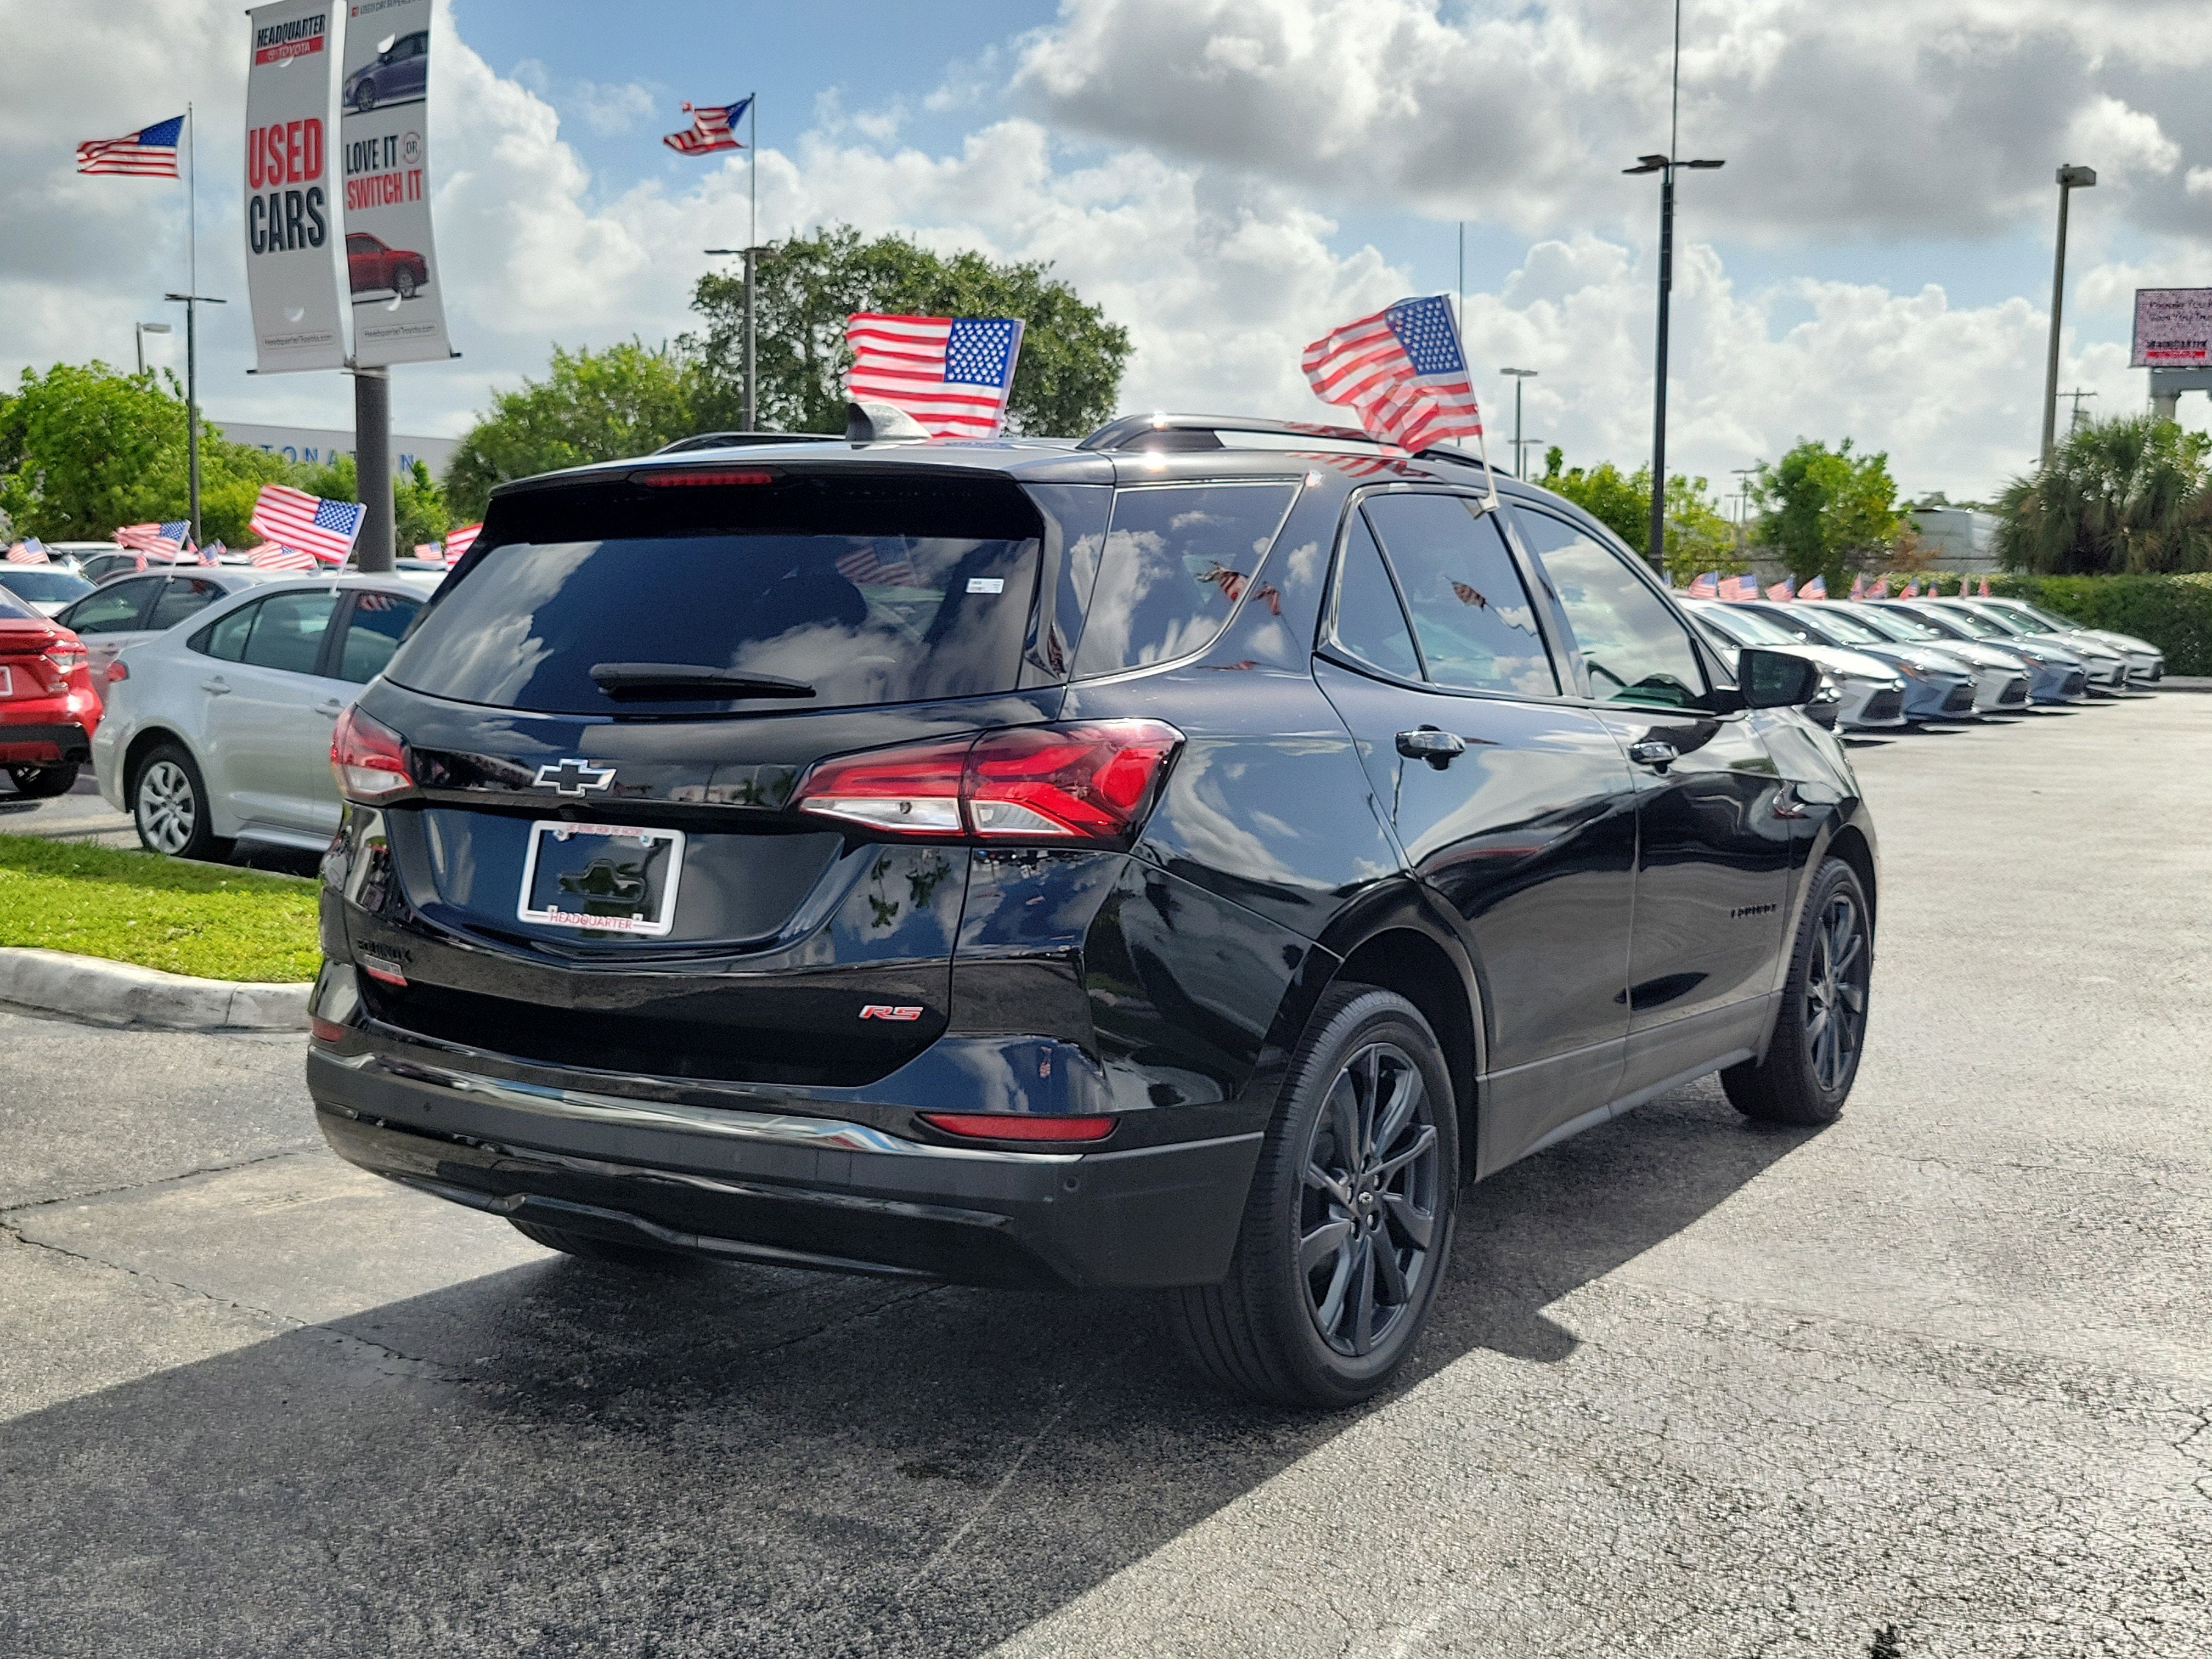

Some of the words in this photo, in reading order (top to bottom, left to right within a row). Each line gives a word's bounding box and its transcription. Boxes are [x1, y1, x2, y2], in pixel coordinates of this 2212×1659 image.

[257, 14, 326, 48] HEADQUARTER
[278, 41, 311, 58] TOYOTA
[249, 117, 325, 190] USED
[346, 139, 380, 176] LOVE
[383, 135, 399, 168] IT
[406, 140, 419, 155] OR
[347, 171, 403, 211] SWITCH
[408, 169, 423, 201] IT
[250, 187, 327, 255] CARS
[550, 911, 634, 930] HEADQUARTER
[859, 1005, 924, 1021] RS
